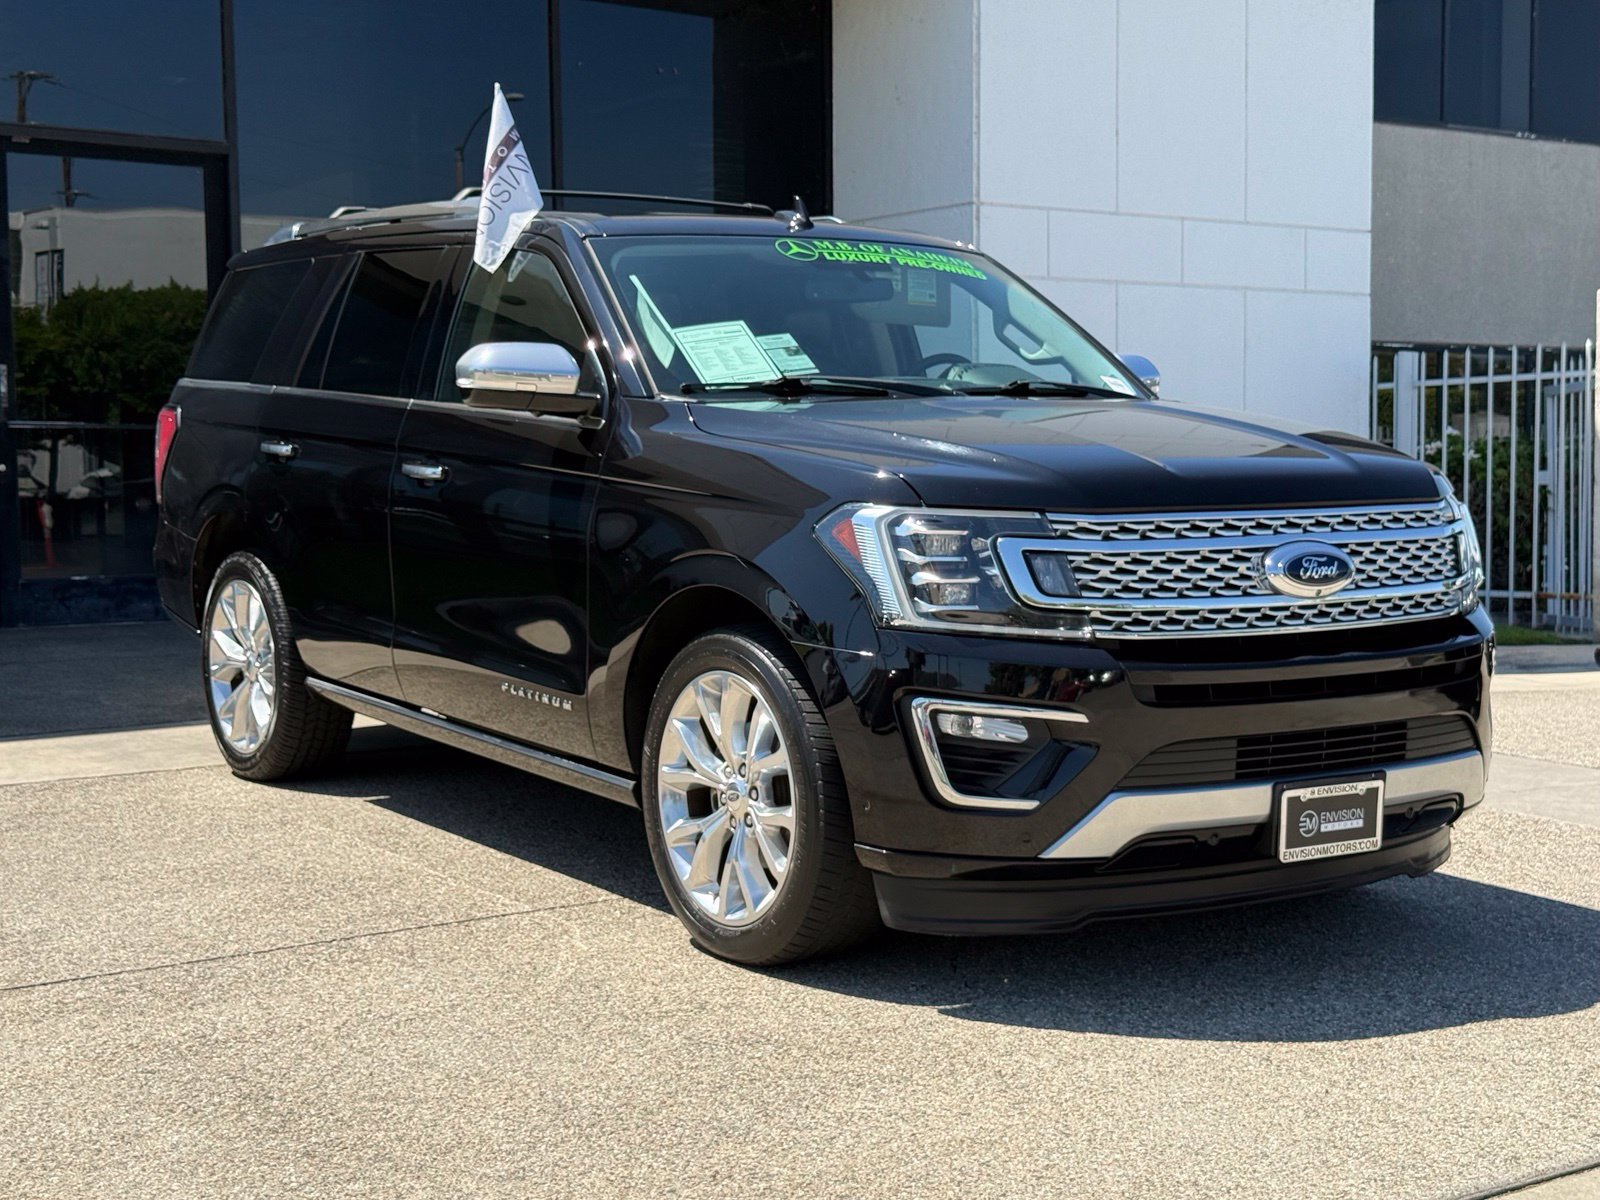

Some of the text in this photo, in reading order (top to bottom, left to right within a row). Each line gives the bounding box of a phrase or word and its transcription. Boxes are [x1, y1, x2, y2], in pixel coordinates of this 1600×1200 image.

[812, 240, 975, 269] M.B. OF ANAHEIM
[823, 251, 988, 281] LUXURY PRE-OWNED
[1300, 556, 1339, 579] Ford
[501, 682, 572, 711] PLATINUM
[1317, 784, 1358, 796] ENVISION
[1320, 807, 1364, 823] ENVISION
[1283, 840, 1378, 860] ENVISIONMOTORS.COM
